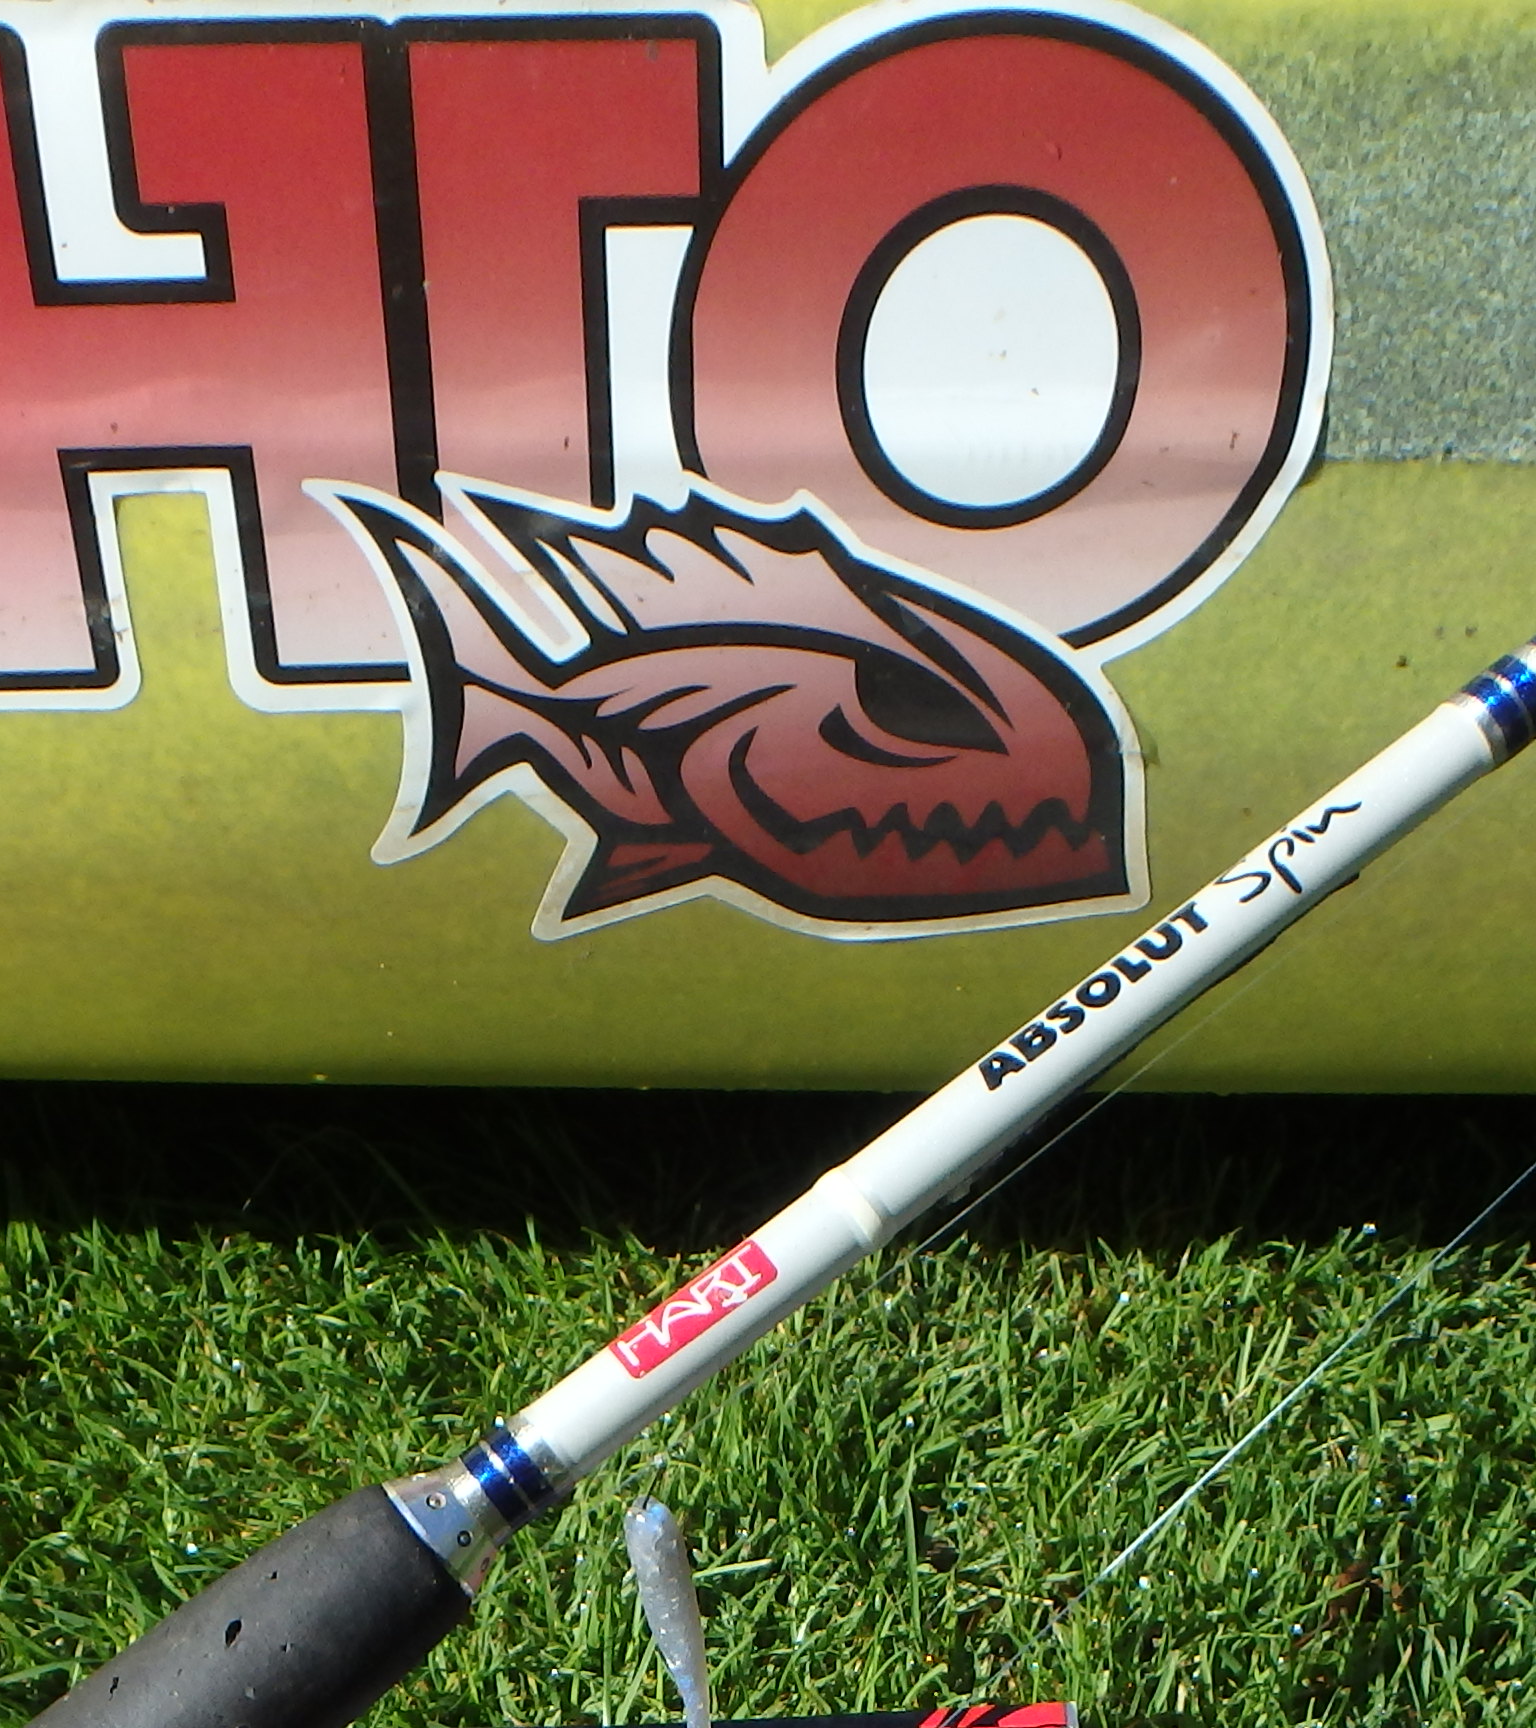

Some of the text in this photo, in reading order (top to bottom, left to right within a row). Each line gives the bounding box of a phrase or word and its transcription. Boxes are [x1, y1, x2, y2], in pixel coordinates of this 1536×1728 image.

[979, 800, 1362, 1091] ABSOLUT Spin
[617, 1244, 766, 1368] HART
